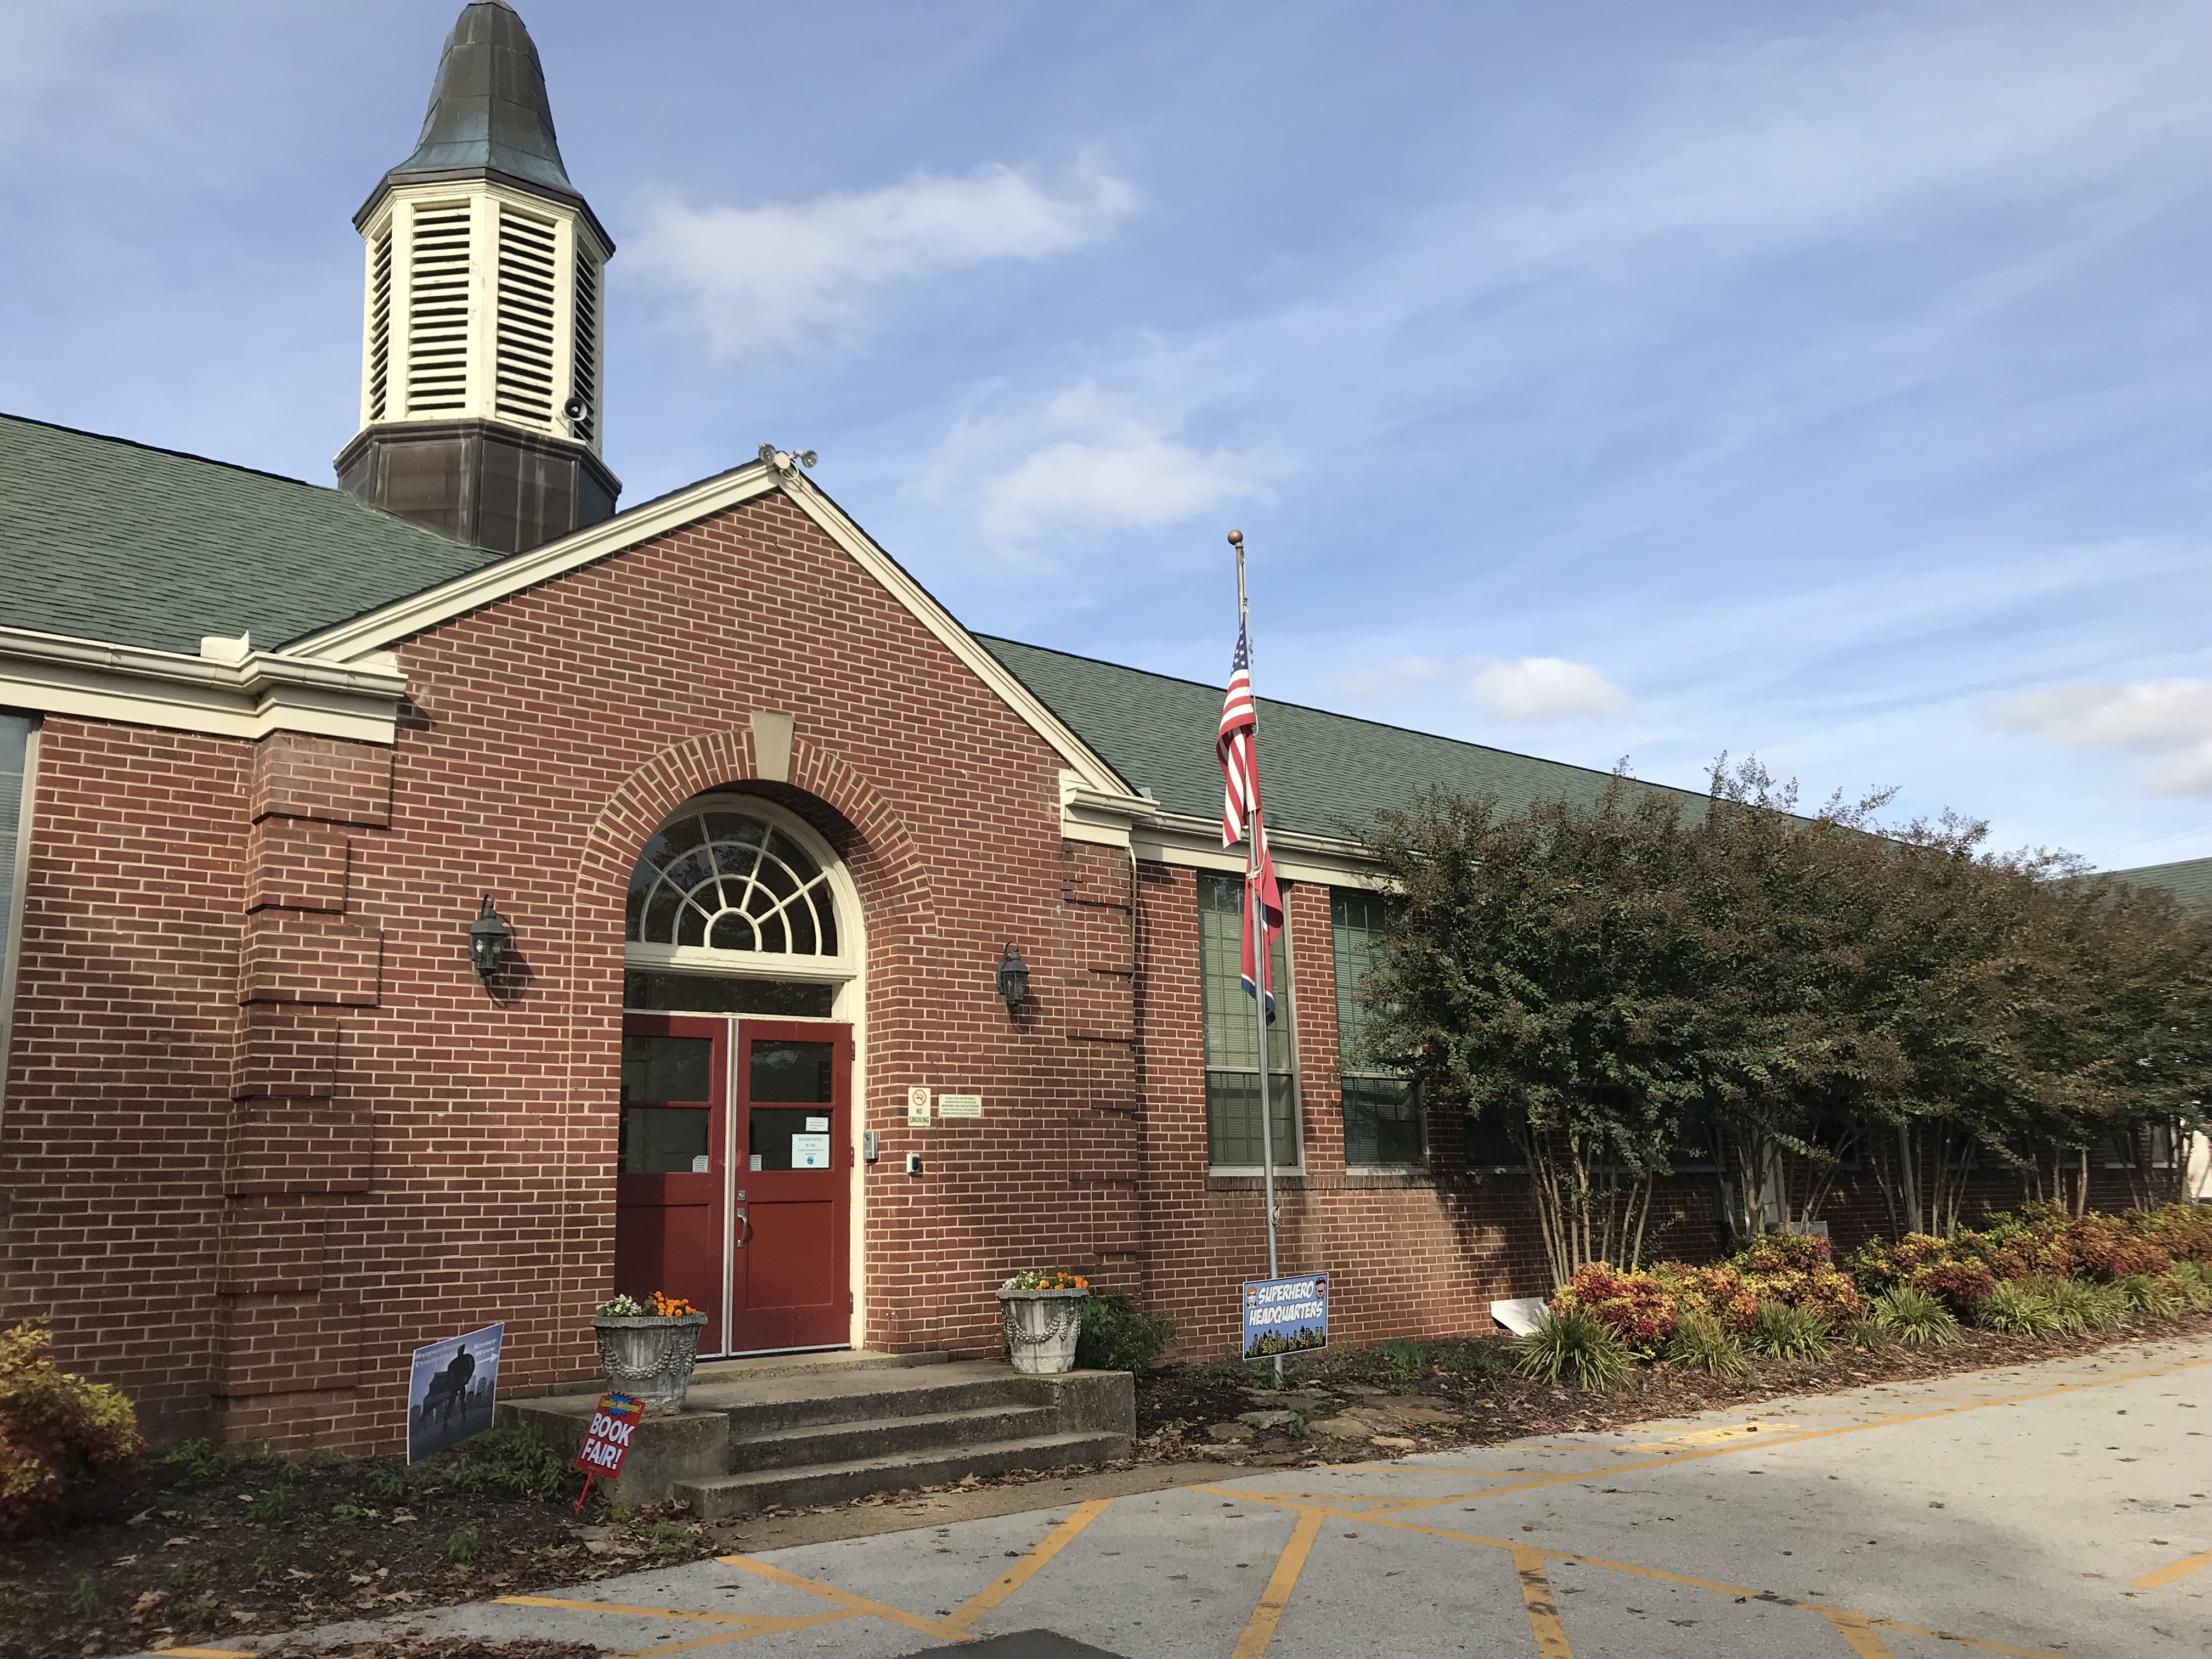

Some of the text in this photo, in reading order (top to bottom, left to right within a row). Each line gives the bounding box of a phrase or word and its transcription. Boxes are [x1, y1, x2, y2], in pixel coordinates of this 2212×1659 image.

[1258, 1280, 1314, 1305] SUPERHERO
[1249, 1300, 1323, 1327] HEADQUARTERS
[589, 1412, 635, 1447] BOOK
[581, 1438, 623, 1470] FAIR!
